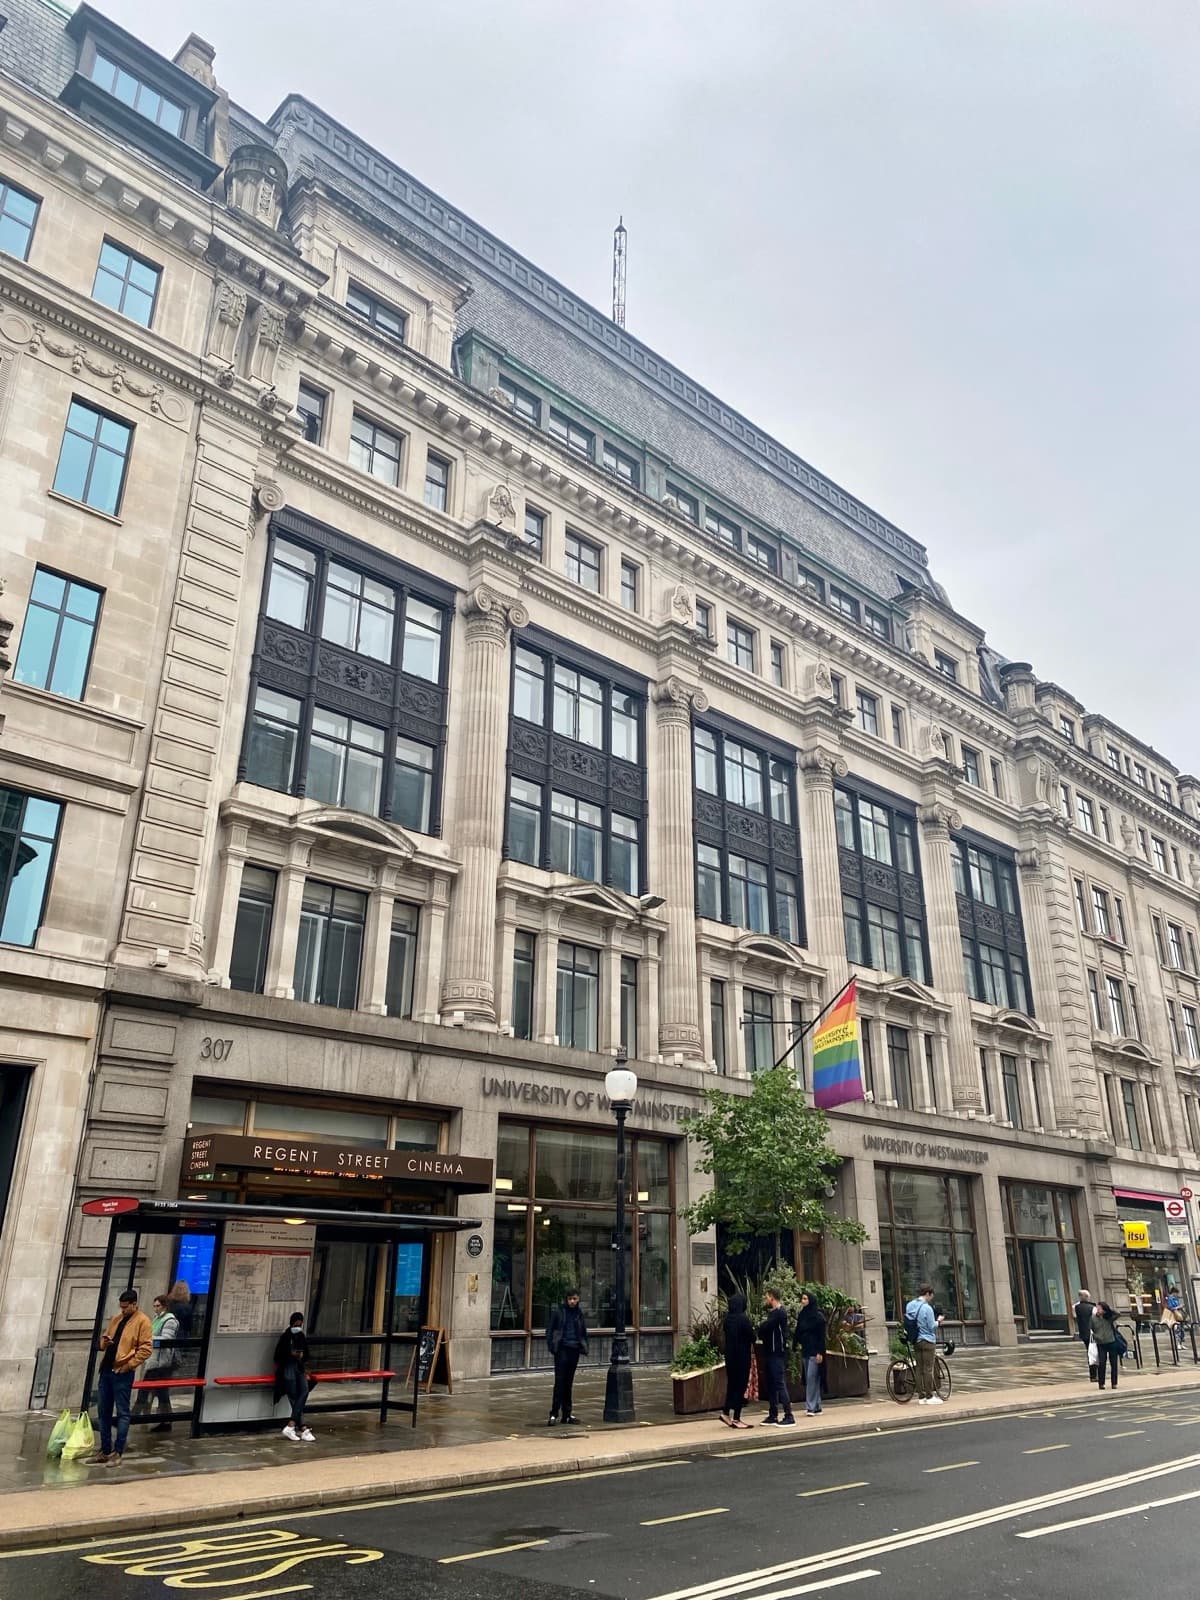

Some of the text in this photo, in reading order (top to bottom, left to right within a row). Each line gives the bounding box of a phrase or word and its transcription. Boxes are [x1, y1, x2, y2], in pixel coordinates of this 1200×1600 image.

[200, 1037, 234, 1061] 307
[481, 1076, 691, 1122] UNIVERSITY OF WMINSTER
[191, 1150, 208, 1160] STREET
[192, 1139, 211, 1150] REGENT
[863, 1134, 984, 1164] UNIVERSITY OF WESTMINSTER
[190, 1160, 209, 1170] CINEMA
[253, 1145, 464, 1175] REGENT STREET CINEMA
[1127, 1231, 1145, 1241] itsu
[79, 1529, 385, 1588] BUS
